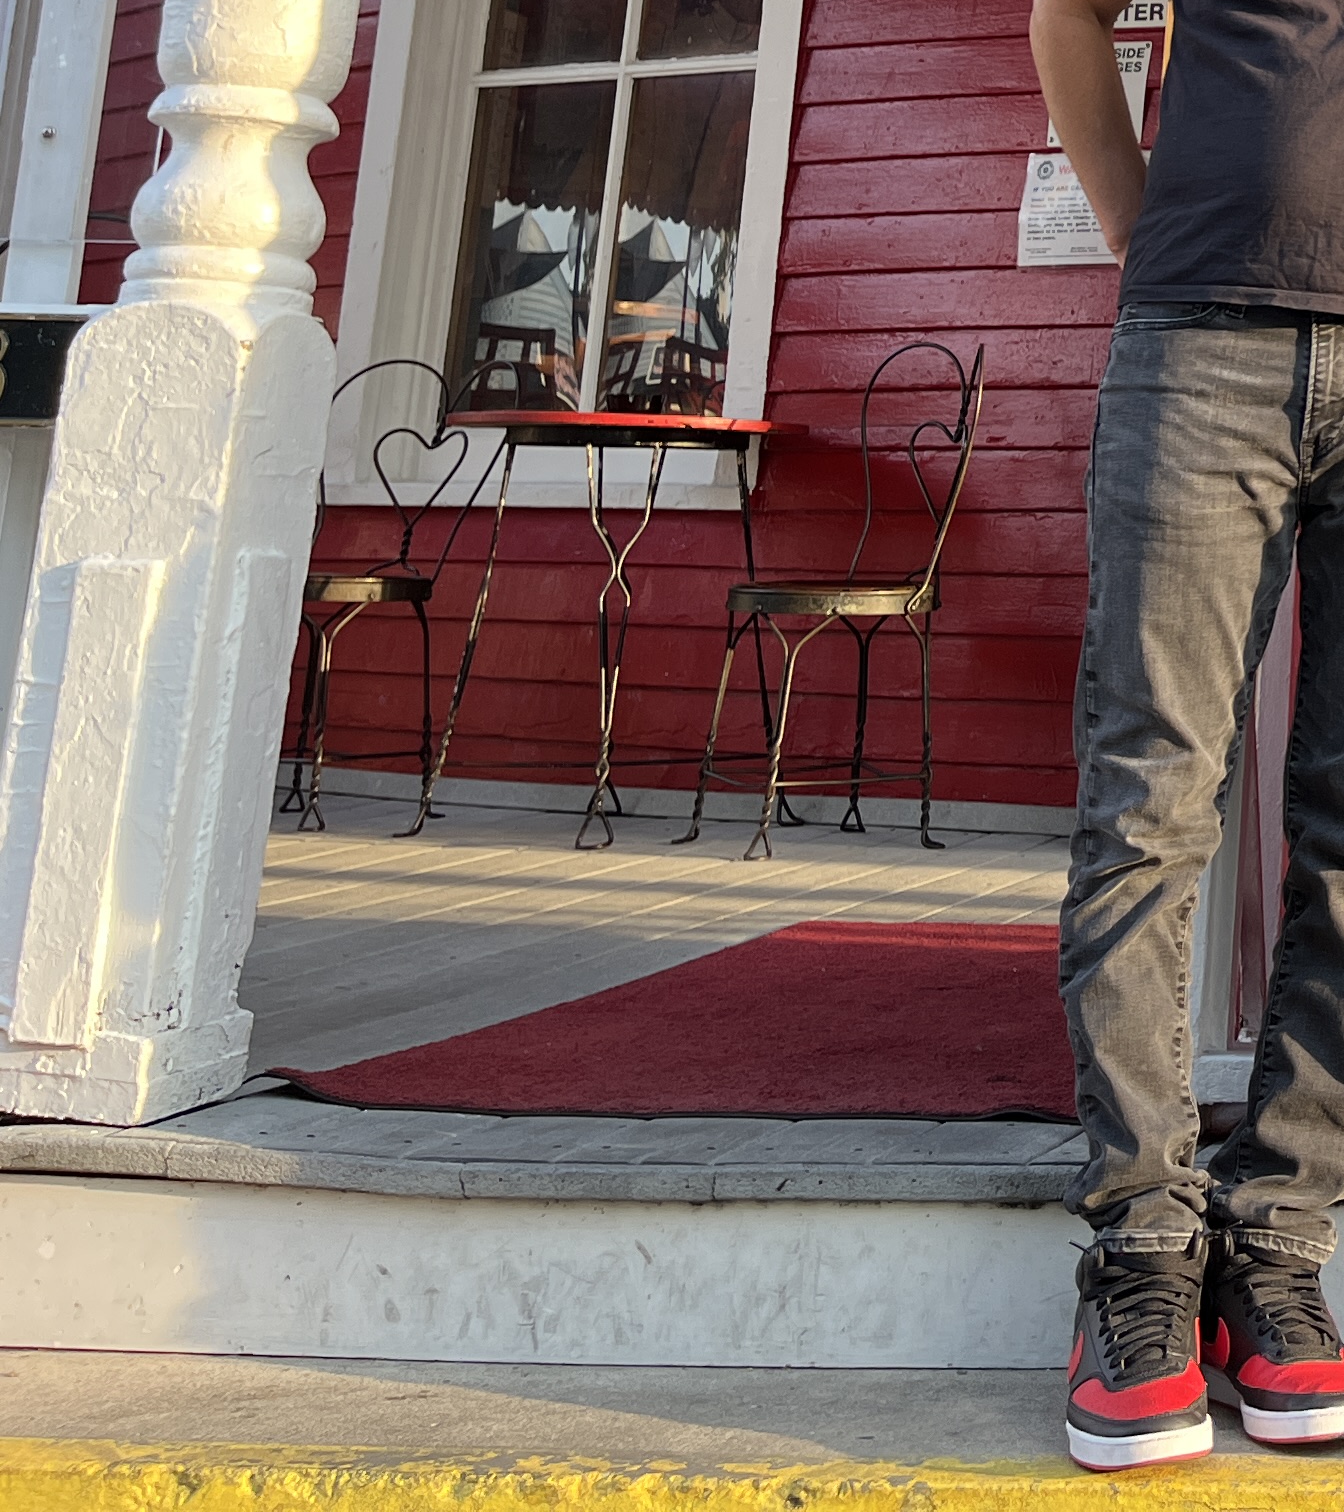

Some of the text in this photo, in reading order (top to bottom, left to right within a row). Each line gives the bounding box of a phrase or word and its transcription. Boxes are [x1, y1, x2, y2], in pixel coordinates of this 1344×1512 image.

[1122, 3, 1164, 21] TER
[1115, 47, 1145, 59] SIDE
[1117, 61, 1142, 73] GES
